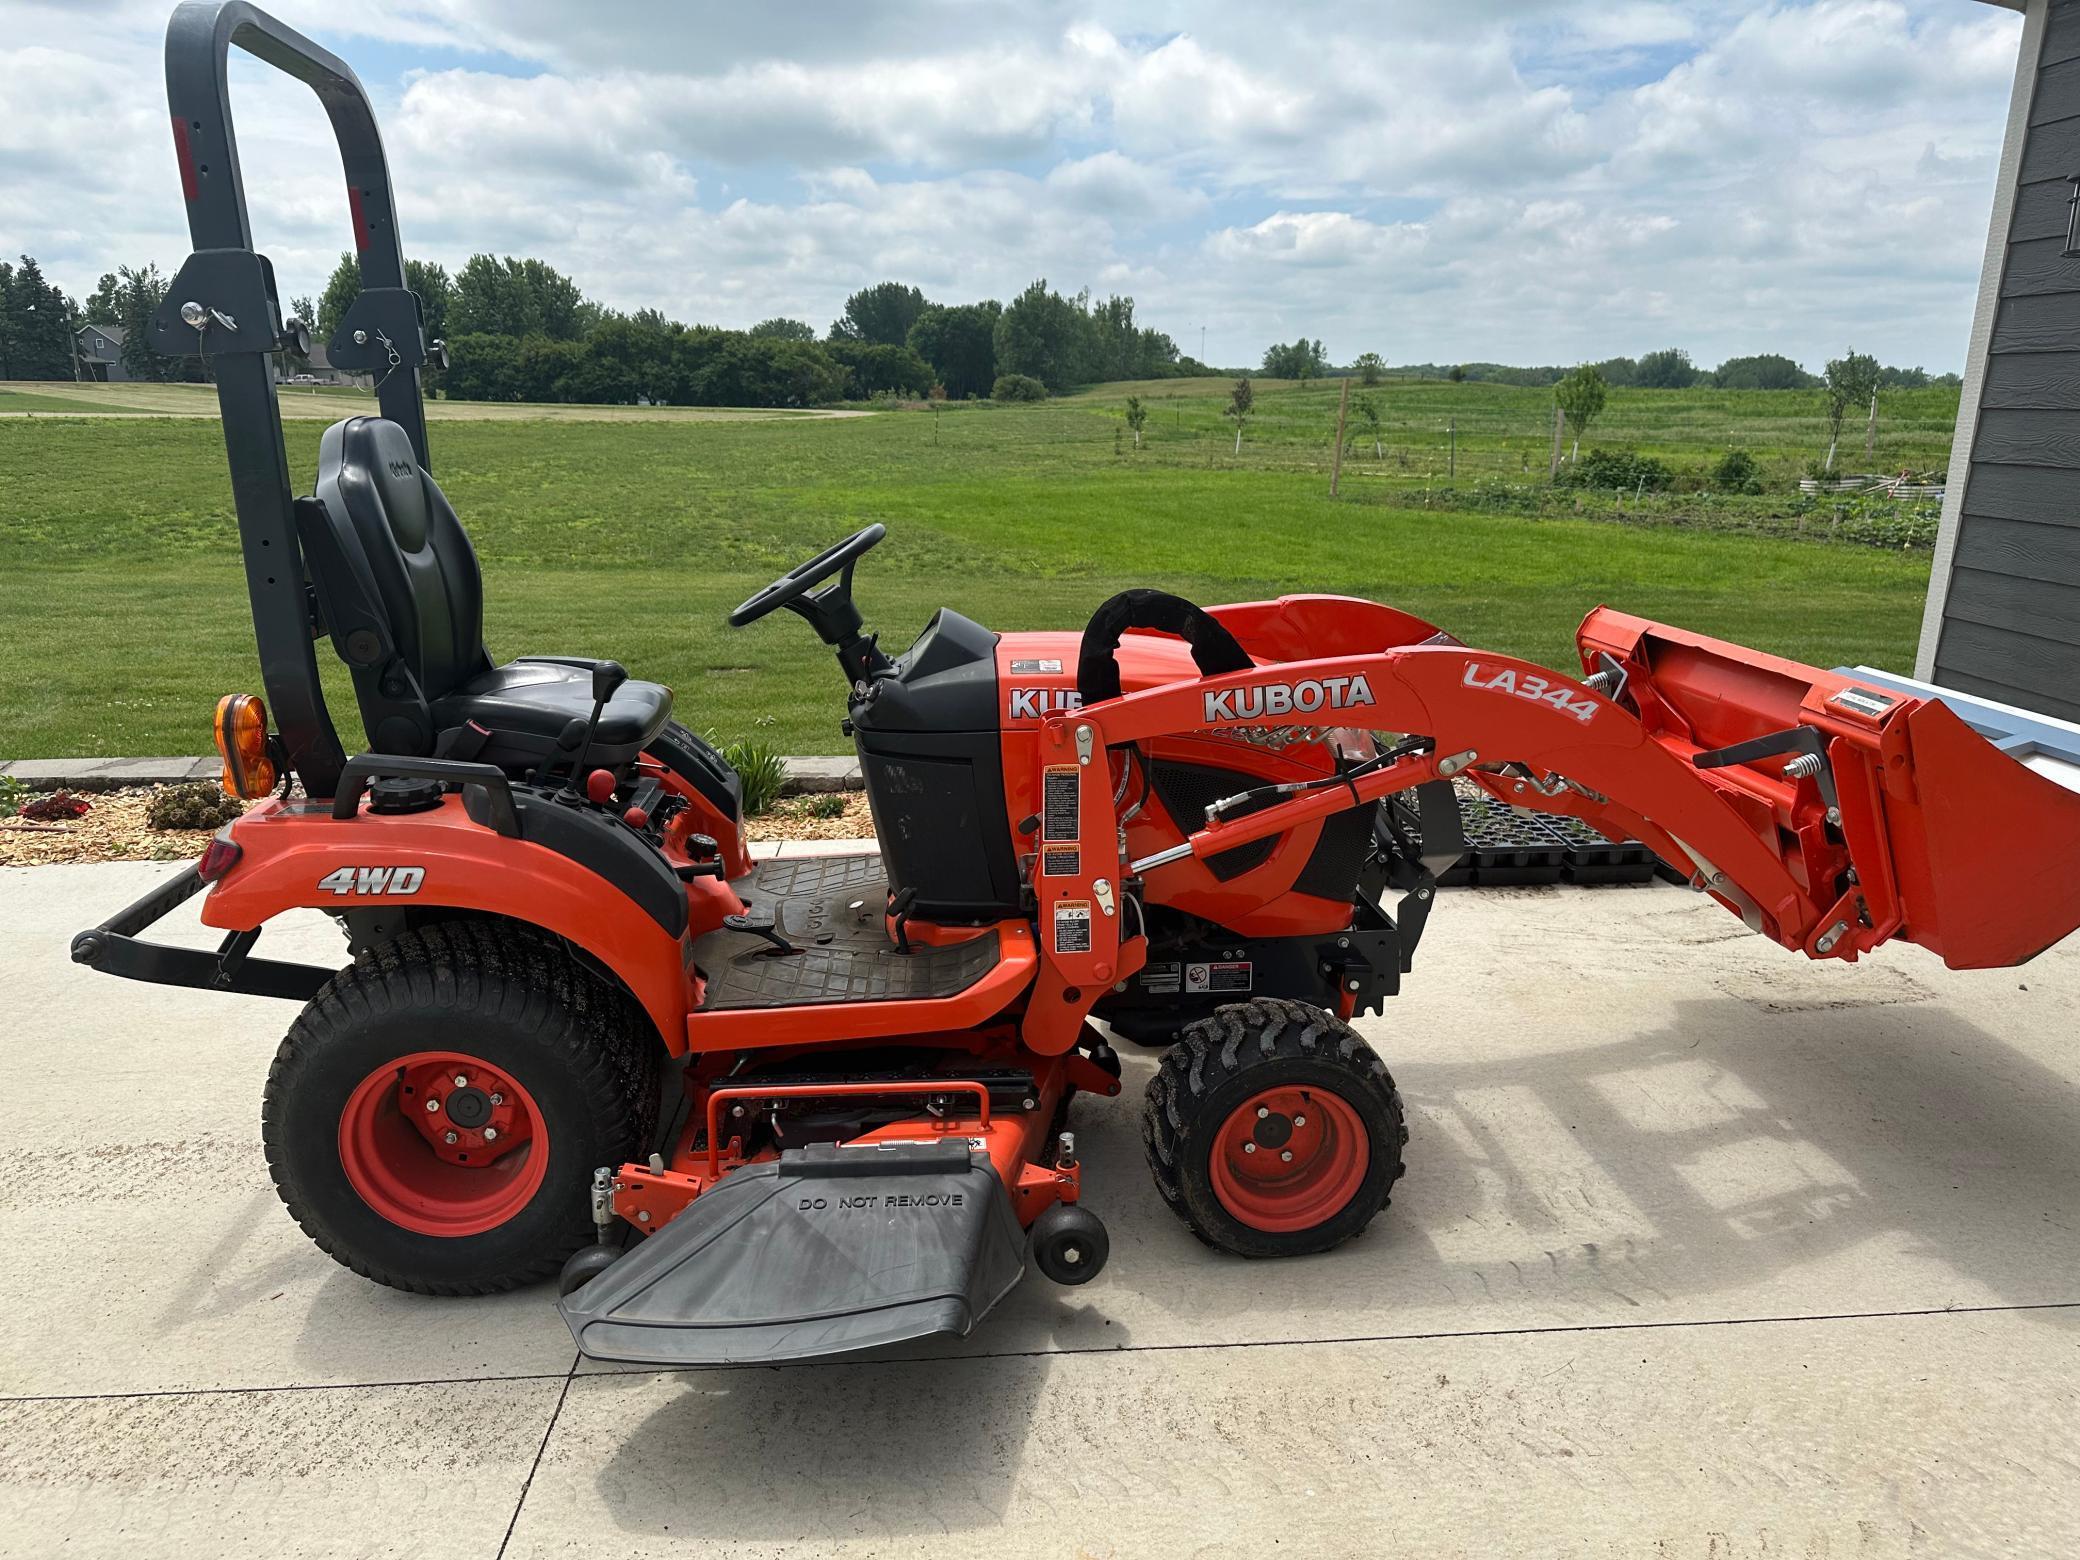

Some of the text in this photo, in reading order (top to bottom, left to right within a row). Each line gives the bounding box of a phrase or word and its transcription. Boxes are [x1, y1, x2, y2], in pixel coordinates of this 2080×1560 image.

[1204, 674, 1377, 723] KUBOTA
[1463, 663, 1600, 722] LA344
[317, 866, 427, 896] 4WD
[798, 1194, 963, 1211] DO NOT REMOVE
